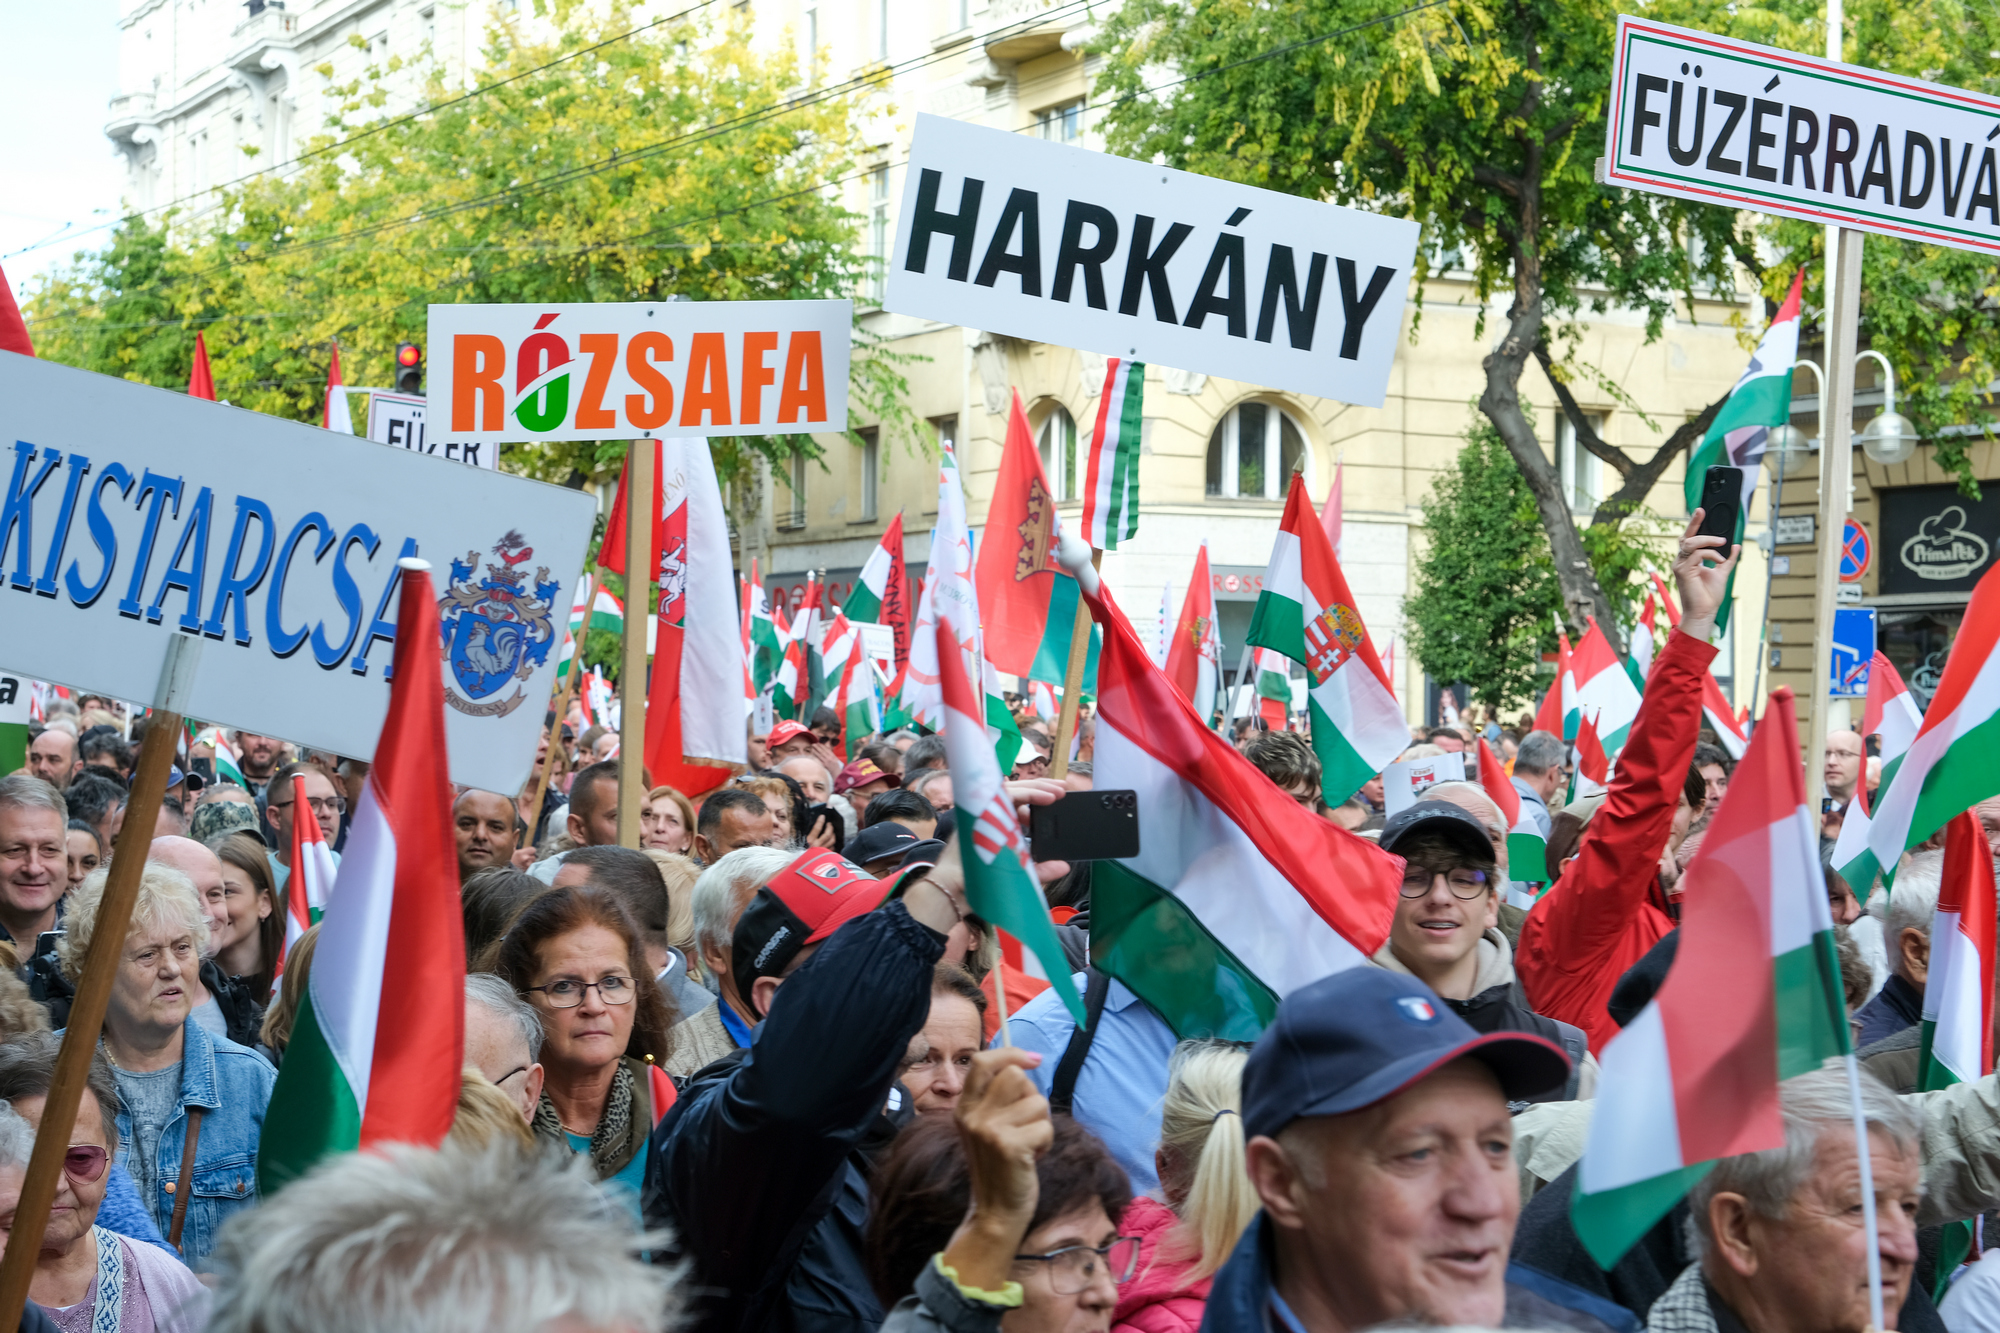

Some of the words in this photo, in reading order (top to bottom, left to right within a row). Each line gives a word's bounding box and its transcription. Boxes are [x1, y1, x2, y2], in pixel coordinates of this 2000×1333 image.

[1630, 62, 2000, 226] FÜZÉRRADVÁ
[904, 167, 1397, 361] HARKÁNY
[451, 313, 828, 432] RÓZSAFA
[0, 440, 418, 682] KISTARCSA
[445, 692, 502, 714] KISTARCSA
